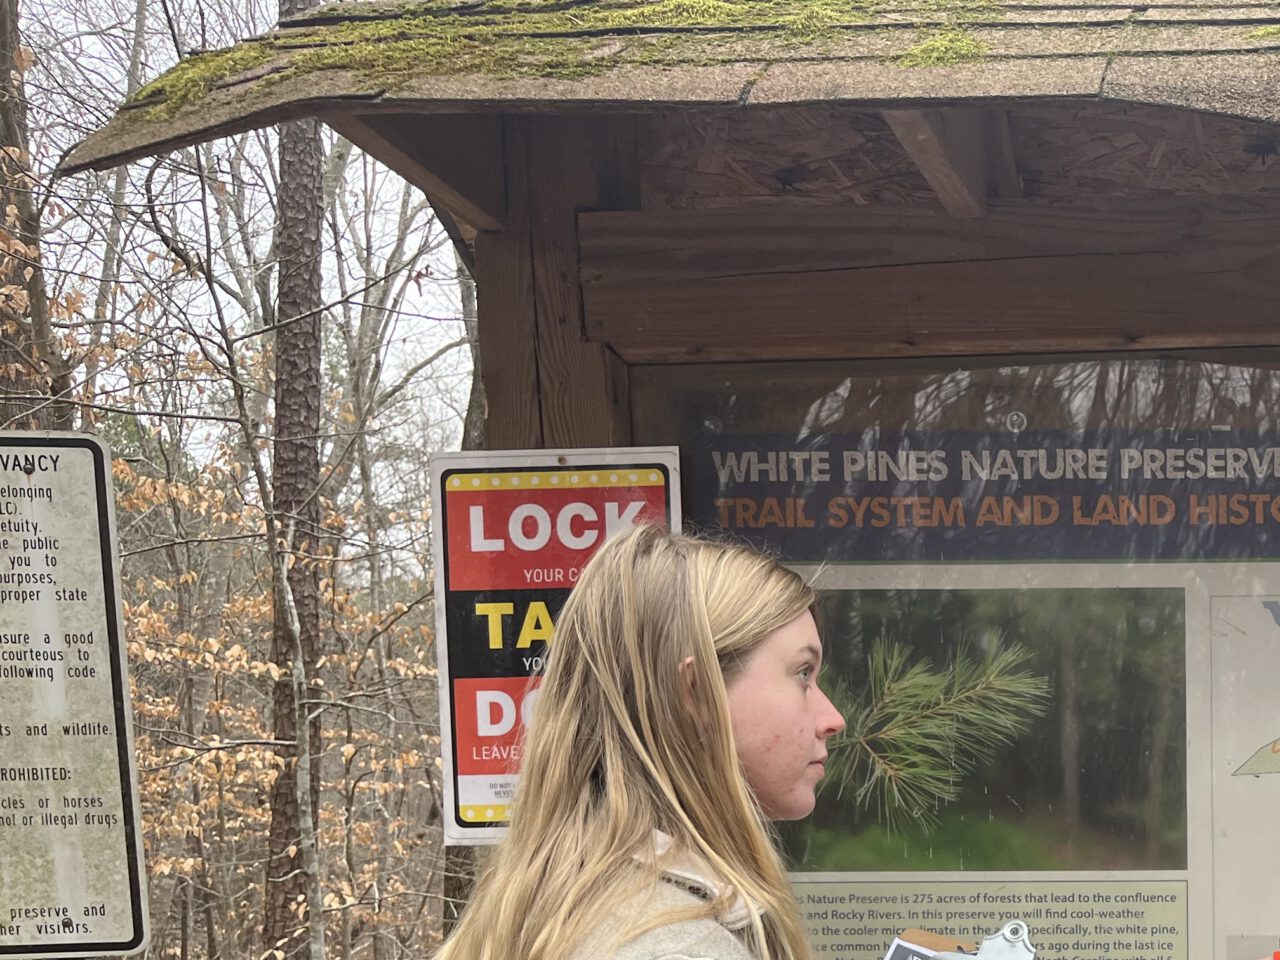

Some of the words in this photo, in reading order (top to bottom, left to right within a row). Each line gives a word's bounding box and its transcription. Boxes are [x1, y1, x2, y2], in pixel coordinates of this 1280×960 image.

[0, 455, 59, 472] VANCY
[712, 450, 830, 482] WHITE
[843, 450, 948, 482] PINES
[962, 448, 1108, 480] NATURE
[1, 484, 52, 502] elonging
[712, 496, 816, 528] TRAIL
[827, 496, 965, 528] SYSTEM
[976, 495, 1060, 527] AND
[1073, 494, 1176, 526] LAND
[1, 519, 42, 536] etuity.
[22, 536, 59, 552] public
[9, 556, 30, 570] you
[45, 554, 57, 566] to
[524, 568, 564, 582] YOUR
[2, 589, 40, 604] proper
[55, 589, 88, 601] state
[44, 633, 50, 644] a
[64, 632, 94, 648] good
[2, 648, 64, 661] courteous
[78, 648, 90, 660] to
[68, 666, 96, 678] code
[26, 723, 47, 736] and
[62, 722, 112, 736] wildlife.
[472, 745, 519, 760] LEAVE
[0, 768, 72, 780] ROHIBITED:
[38, 798, 50, 808] or
[64, 796, 103, 808] horses
[22, 816, 33, 826] or
[41, 812, 78, 829] illegal
[85, 812, 118, 829] drugs
[807, 894, 846, 904] Nature
[848, 894, 898, 904] Preserve
[901, 894, 909, 904] is
[912, 894, 933, 904] 275
[936, 896, 966, 904] acres
[969, 893, 982, 904] of
[983, 892, 1022, 904] forests
[1025, 892, 1048, 903] that
[1050, 892, 1074, 902] lead
[1078, 894, 1089, 902] to
[1093, 892, 1111, 902] the
[1114, 892, 1176, 902] confluence
[10, 907, 68, 921] preserve
[84, 904, 106, 916] and
[807, 910, 828, 920] and
[832, 910, 864, 922] Rocky
[868, 910, 906, 920] Rivers.
[908, 910, 919, 920] In
[922, 910, 942, 920] this
[946, 910, 995, 922] preserve
[998, 911, 1020, 921] you
[1023, 909, 1042, 919] will
[1046, 908, 1067, 918] find
[1070, 908, 1144, 919] cool-weather
[36, 922, 92, 934] visitors.
[822, 926, 840, 936] the
[844, 925, 879, 936] cooler
[959, 925, 969, 935] in
[972, 925, 992, 935] the
[1026, 924, 1091, 936] Specifically,
[1094, 924, 1113, 934] the
[1116, 924, 1148, 934] white
[1151, 924, 1179, 937] pine,
[830, 943, 880, 952] common
[1048, 942, 1069, 952] ago
[1072, 940, 1110, 952] during
[1113, 940, 1130, 950] the
[1134, 940, 1154, 950] last
[1158, 940, 1173, 950] ice
